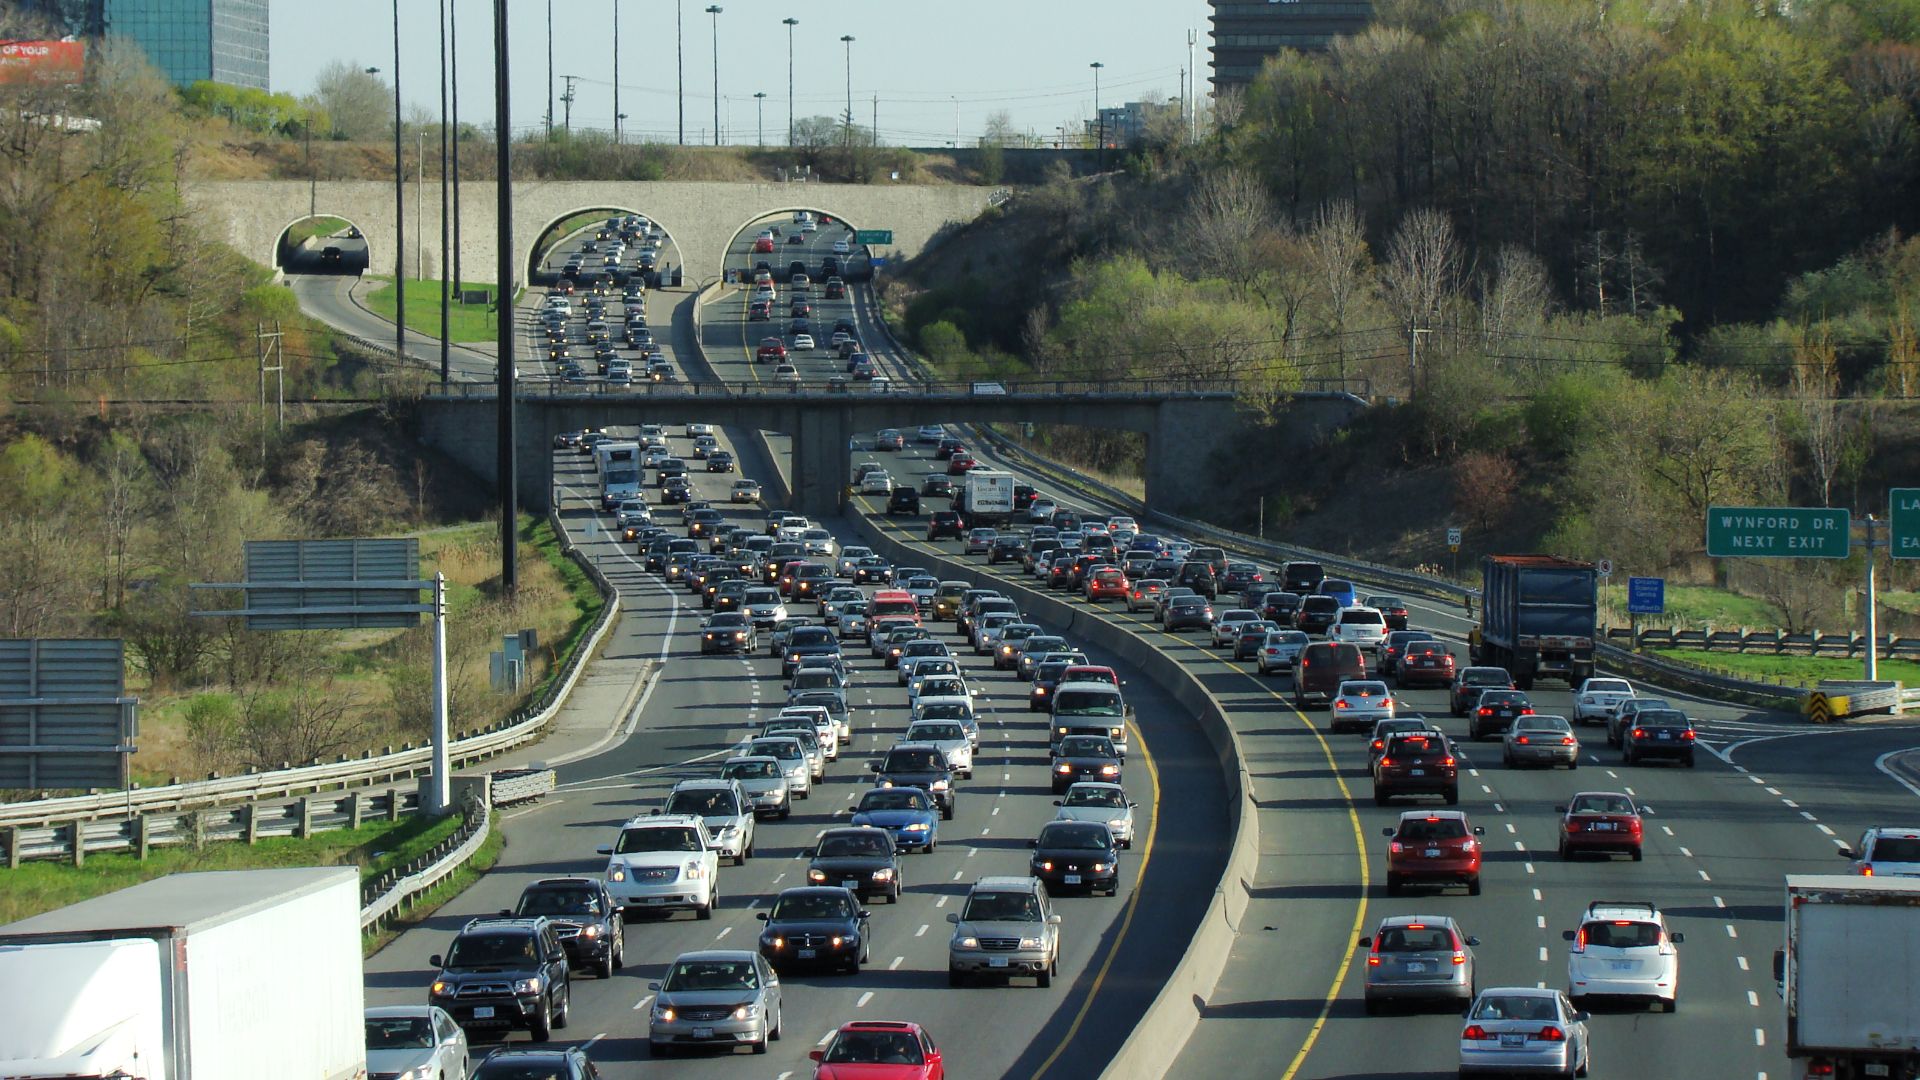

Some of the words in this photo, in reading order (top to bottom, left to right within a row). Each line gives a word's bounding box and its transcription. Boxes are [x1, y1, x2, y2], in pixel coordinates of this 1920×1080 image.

[3, 46, 18, 54] OF
[20, 46, 49, 54] YOUR
[1721, 516, 1800, 530] WYNFORD
[1813, 518, 1839, 530] DR.
[1732, 536, 1774, 548] NEXT
[1788, 537, 1825, 549] EXIT
